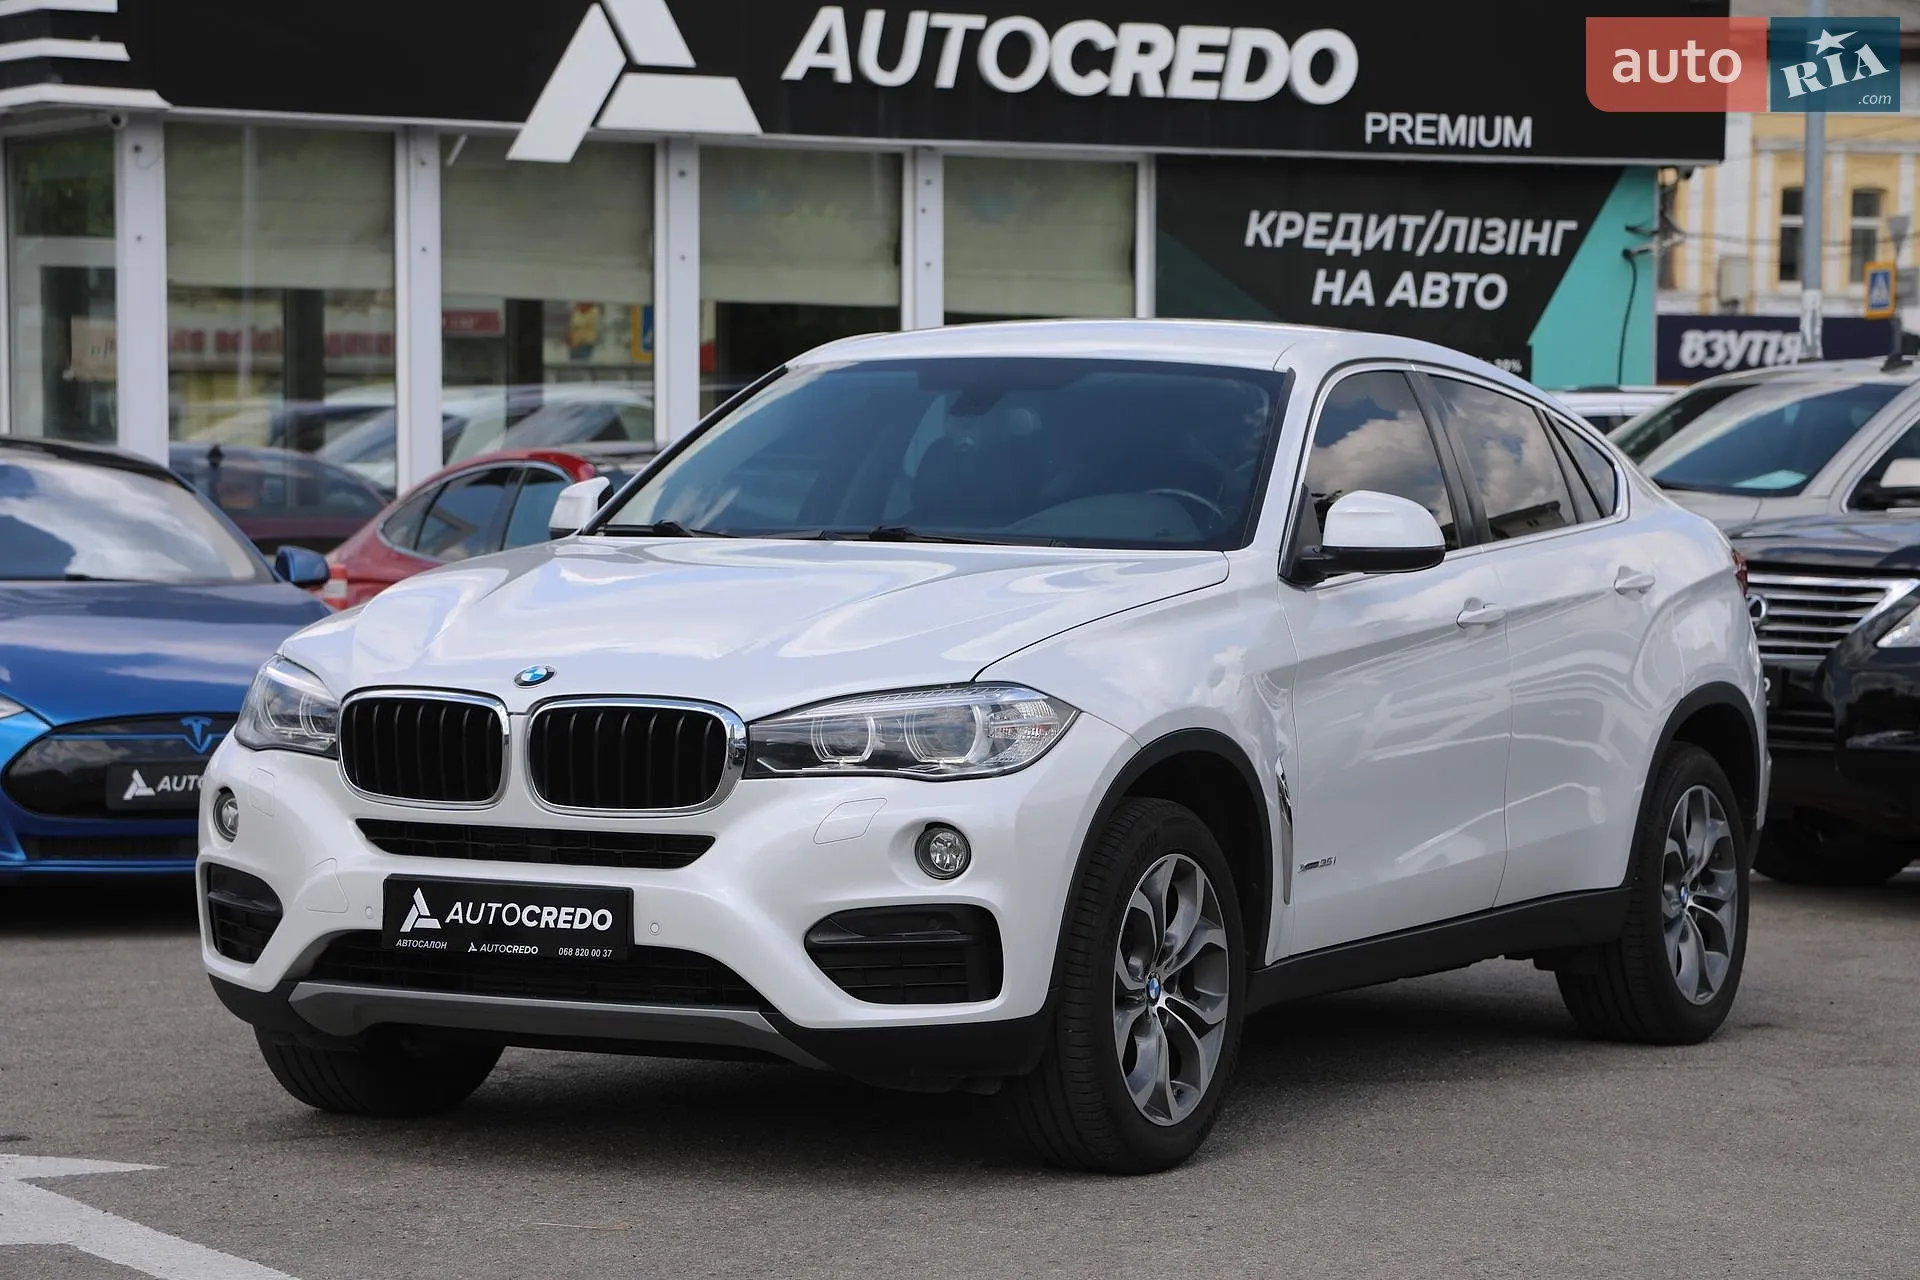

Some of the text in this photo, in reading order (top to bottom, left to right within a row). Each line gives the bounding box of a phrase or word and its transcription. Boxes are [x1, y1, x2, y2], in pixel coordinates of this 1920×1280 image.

[781, 6, 1358, 105] AUTOCREDO
[1365, 112, 1532, 148] PREMIUM
[1244, 209, 1578, 257] КРЕДИТ/ЛІЗІНГ
[1311, 269, 1509, 311] НА АВТО
[445, 901, 613, 931] AUTOCREDO
[395, 938, 448, 950] АВТОСАЛОН
[479, 943, 539, 955] AUTOCREDO
[558, 947, 613, 958] 068 820 00 37
